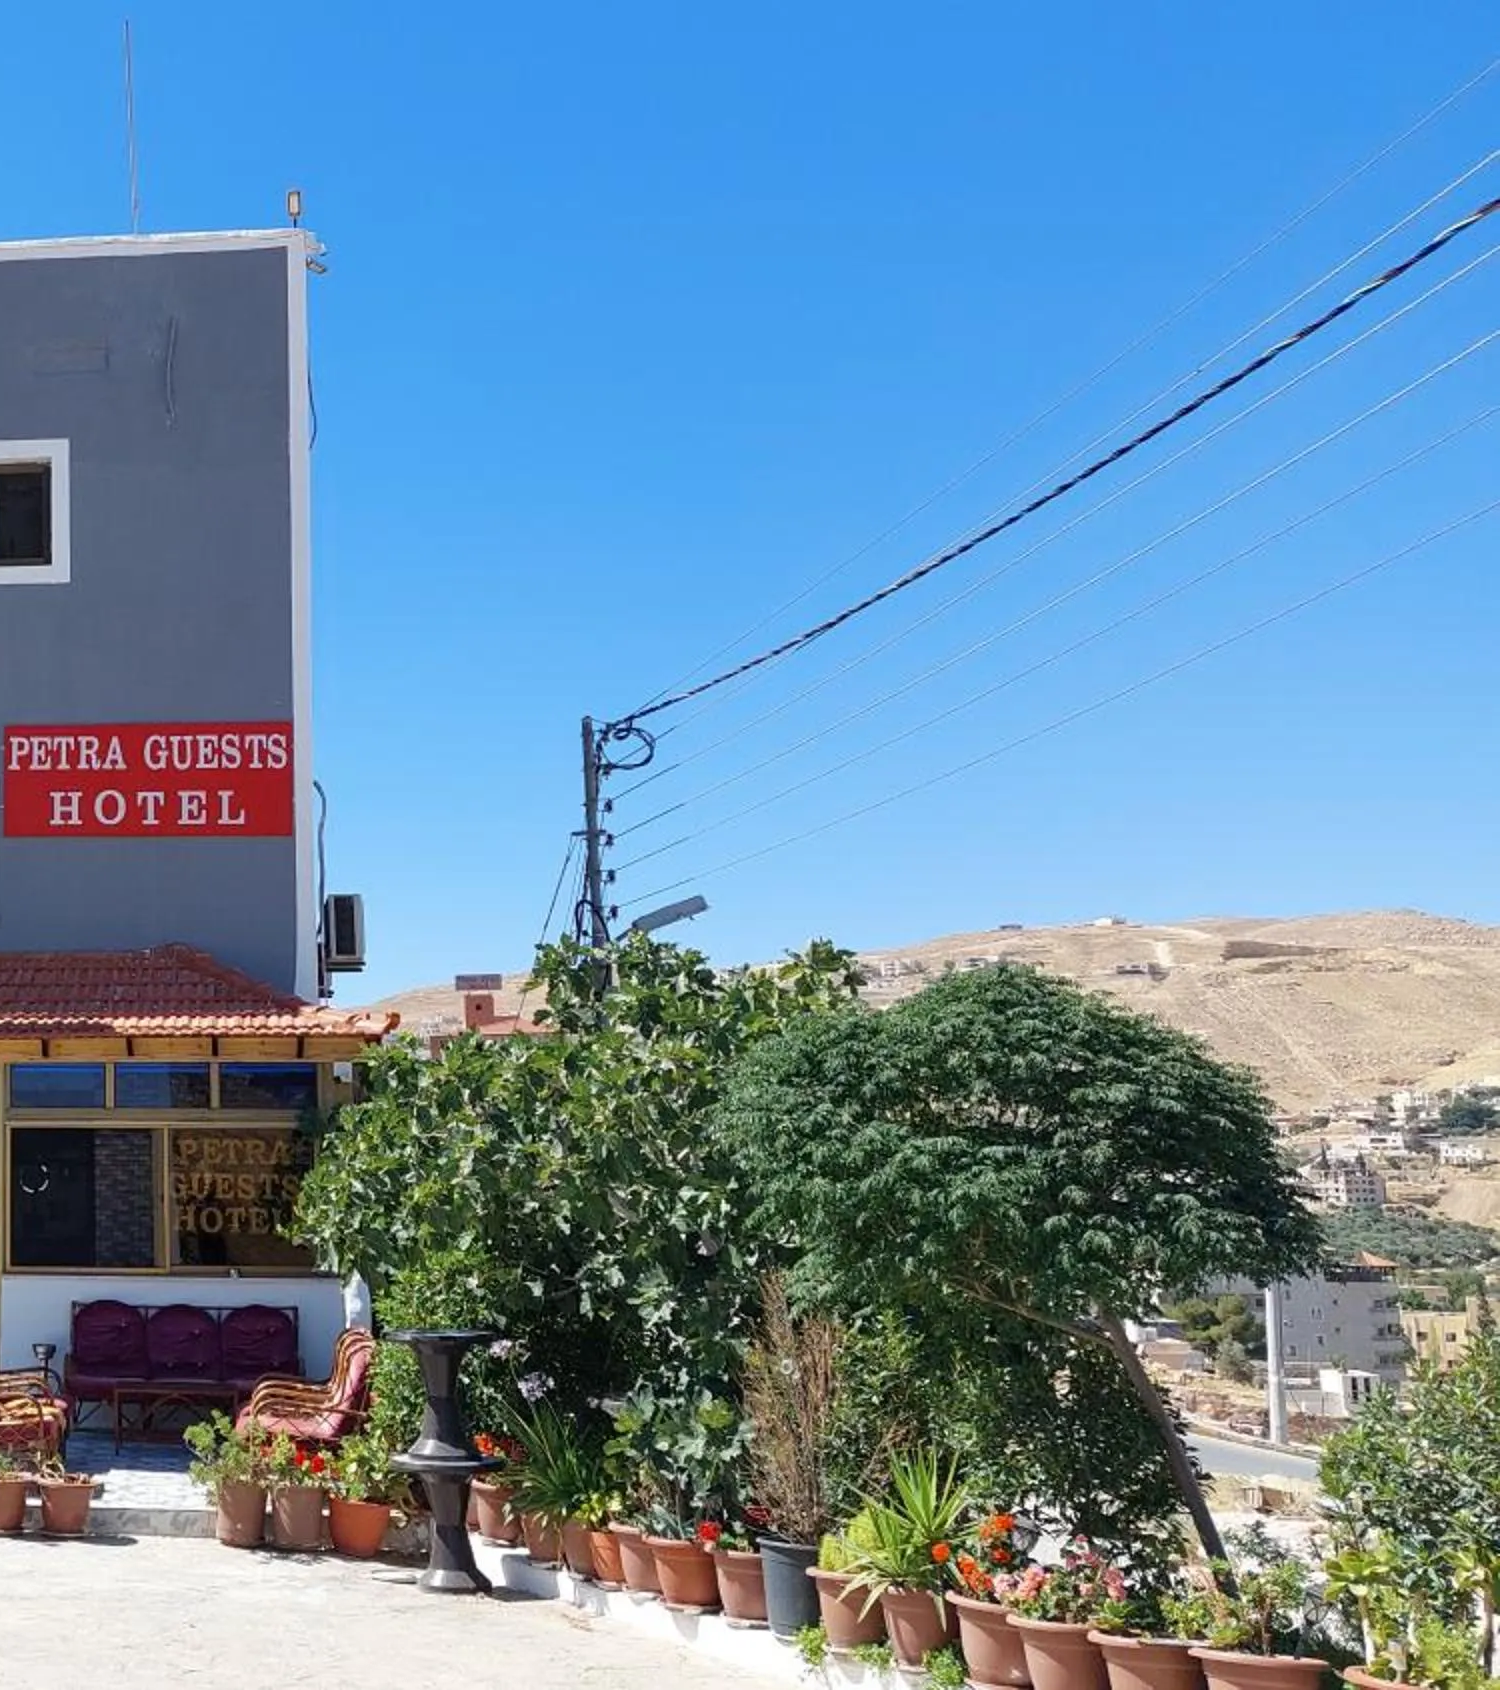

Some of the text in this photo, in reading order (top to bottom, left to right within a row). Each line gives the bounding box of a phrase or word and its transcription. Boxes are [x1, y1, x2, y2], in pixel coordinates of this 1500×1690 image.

[7, 734, 289, 771] PETRA GUESTS
[49, 789, 246, 826] HOTEL
[177, 1137, 292, 1166] PETRA
[170, 1171, 300, 1201] GUESTS
